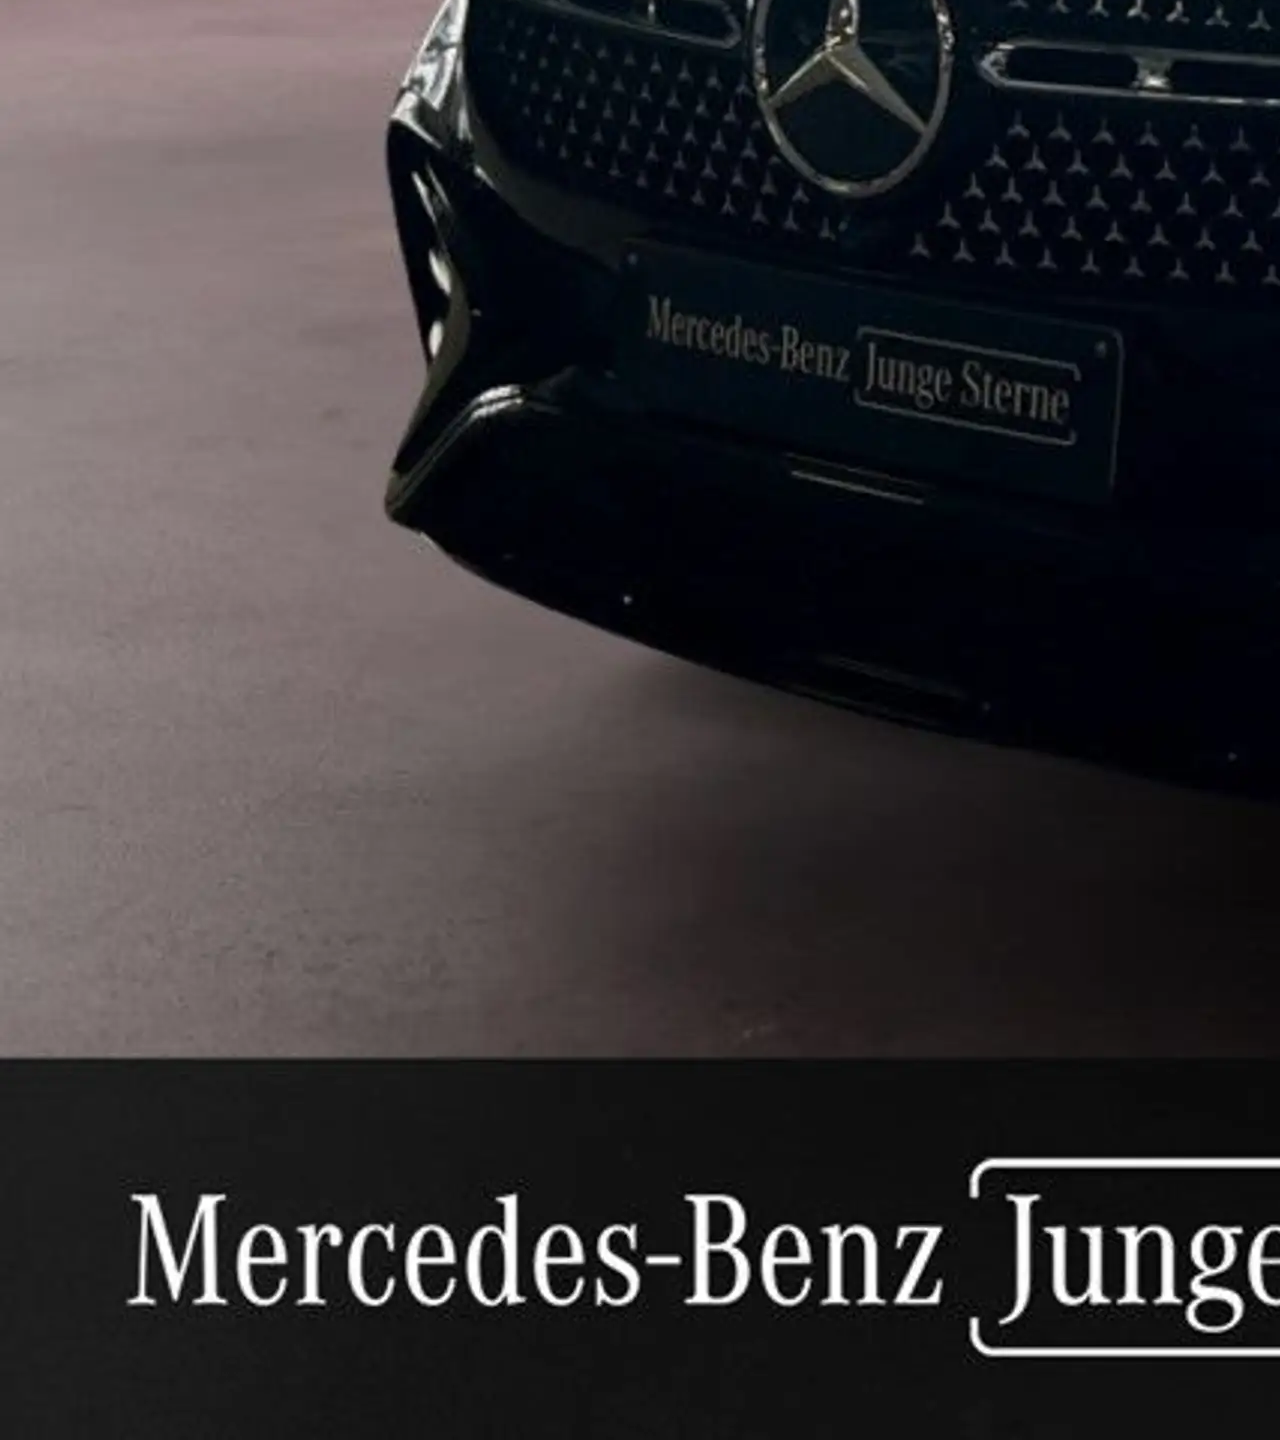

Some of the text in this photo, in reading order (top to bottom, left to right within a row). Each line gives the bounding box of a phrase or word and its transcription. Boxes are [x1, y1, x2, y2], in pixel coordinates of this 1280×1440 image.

[646, 294, 1071, 424] Mercedes-Benz Junge Sterne
